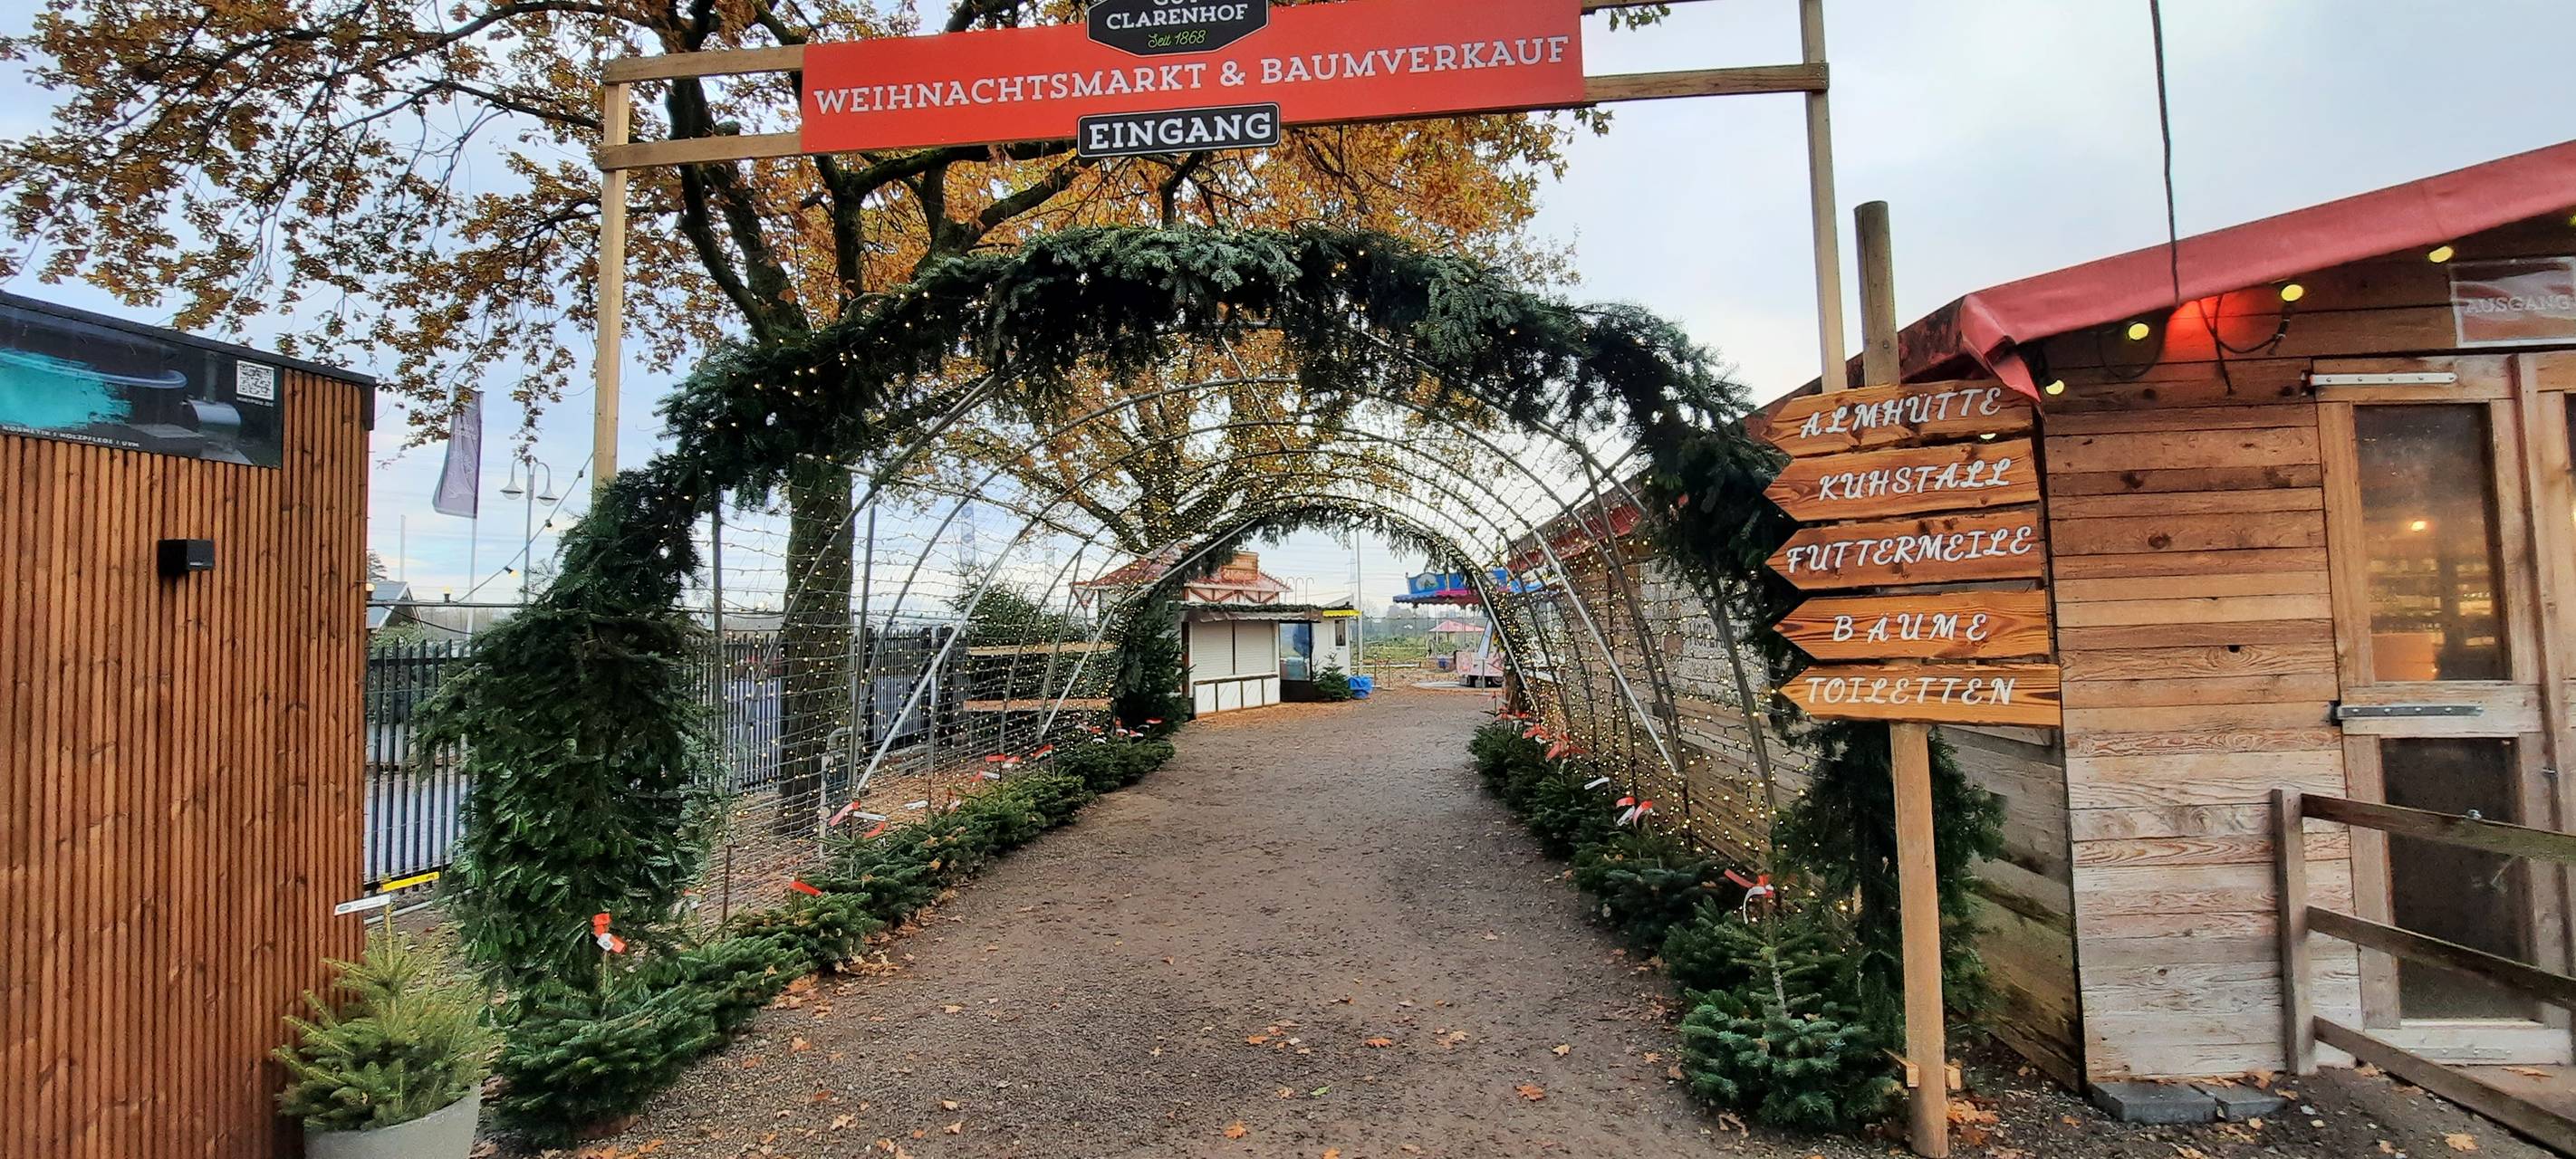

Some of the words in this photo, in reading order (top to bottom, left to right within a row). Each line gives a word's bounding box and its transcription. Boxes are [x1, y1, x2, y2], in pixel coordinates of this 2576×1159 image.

[1106, 4, 1248, 30] CLARENHOF
[1148, 34, 1172, 48] Seit
[1175, 30, 1206, 44] 1868
[813, 62, 1206, 114] WEIHNACHTSMARKT
[1219, 61, 1246, 87] &
[1260, 36, 1569, 84] BAUMVERKAUF
[1089, 112, 1272, 150] EINGANG
[2465, 293, 2571, 313] AUSGANG
[1799, 387, 2002, 439] ALMHÜTTE
[1819, 458, 2012, 502] KUHSTALL
[1786, 526, 2033, 574] FUTTERMEILE
[1832, 611, 1987, 644] BÄUME
[1805, 676, 2014, 705] TOILETTEN
